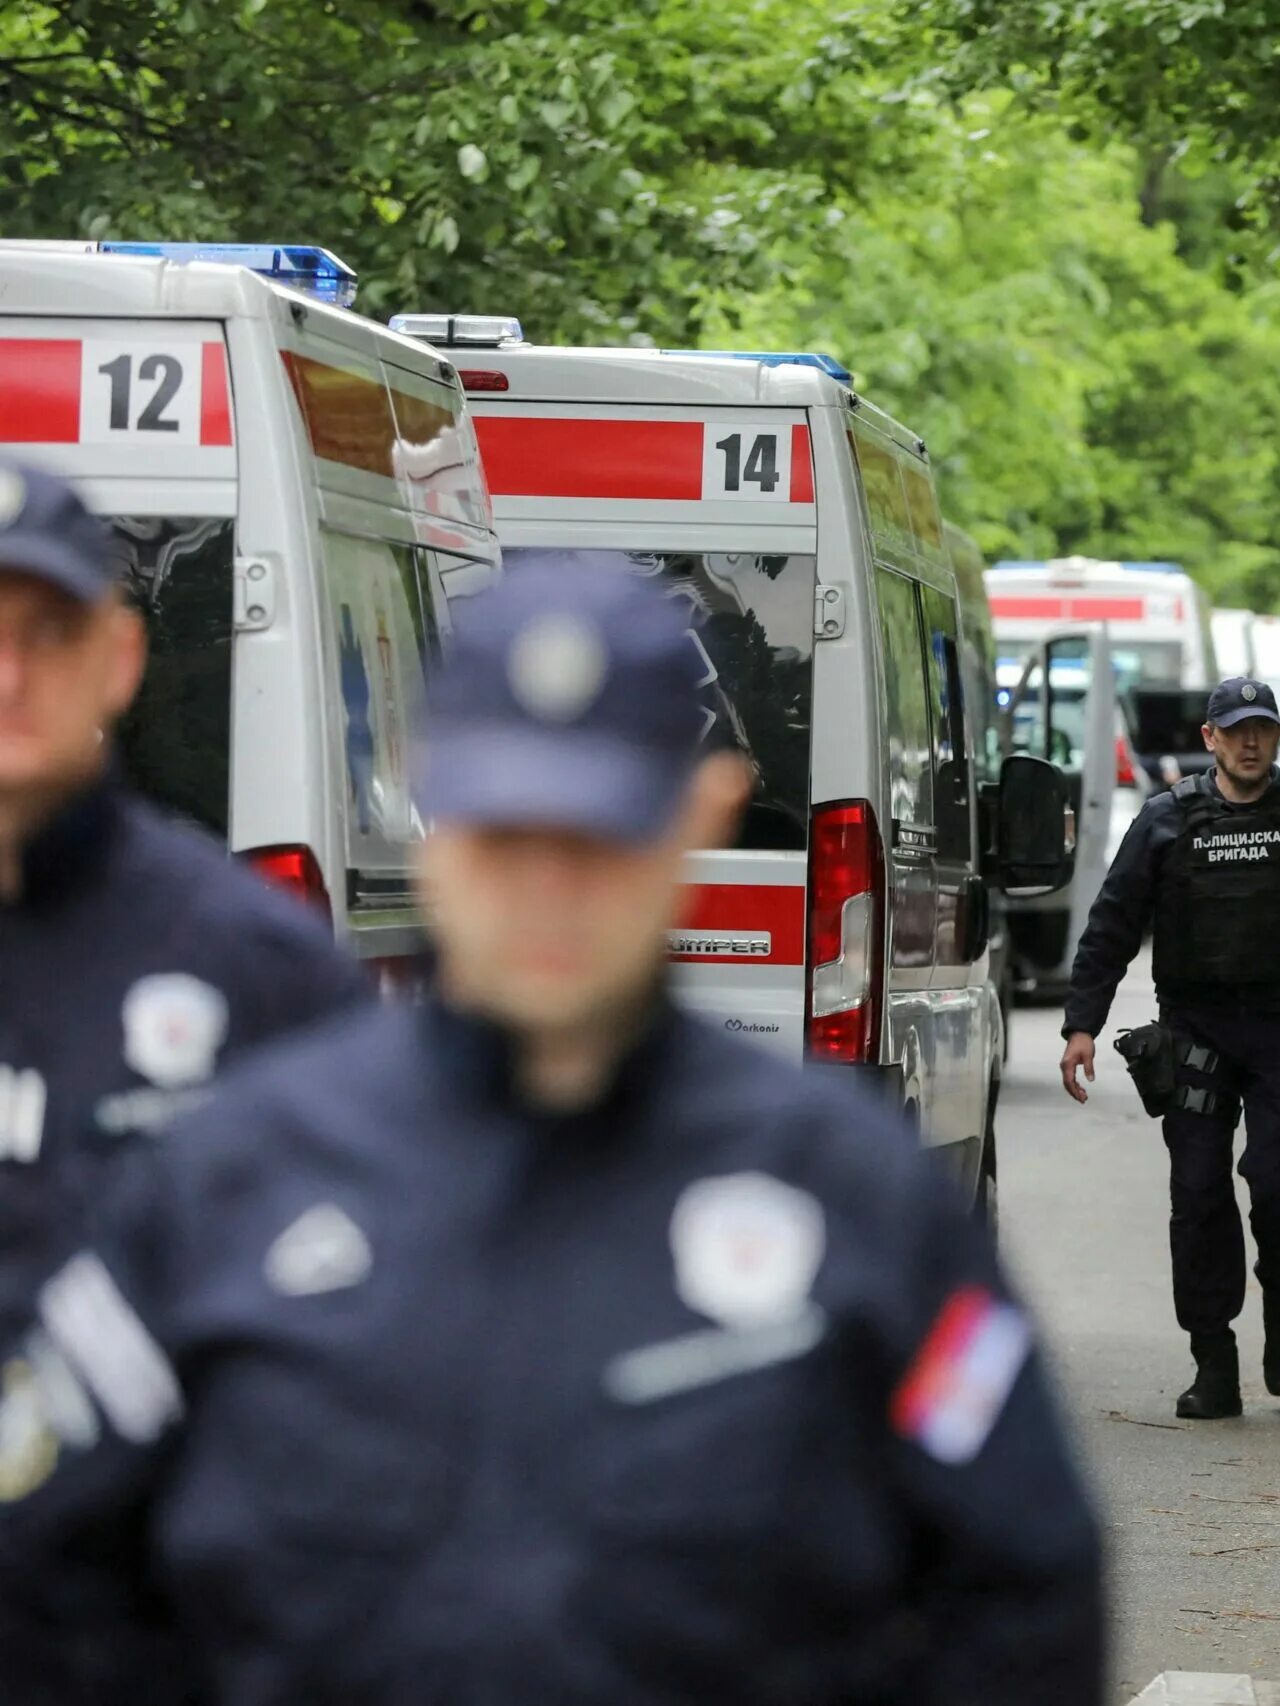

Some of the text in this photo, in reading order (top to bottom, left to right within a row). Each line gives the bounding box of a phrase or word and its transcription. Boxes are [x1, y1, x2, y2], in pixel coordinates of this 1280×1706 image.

[98, 353, 184, 433] 12
[715, 433, 780, 493] 14
[1208, 846, 1269, 862] БРИГАДА
[724, 1018, 780, 1033] Markonis
